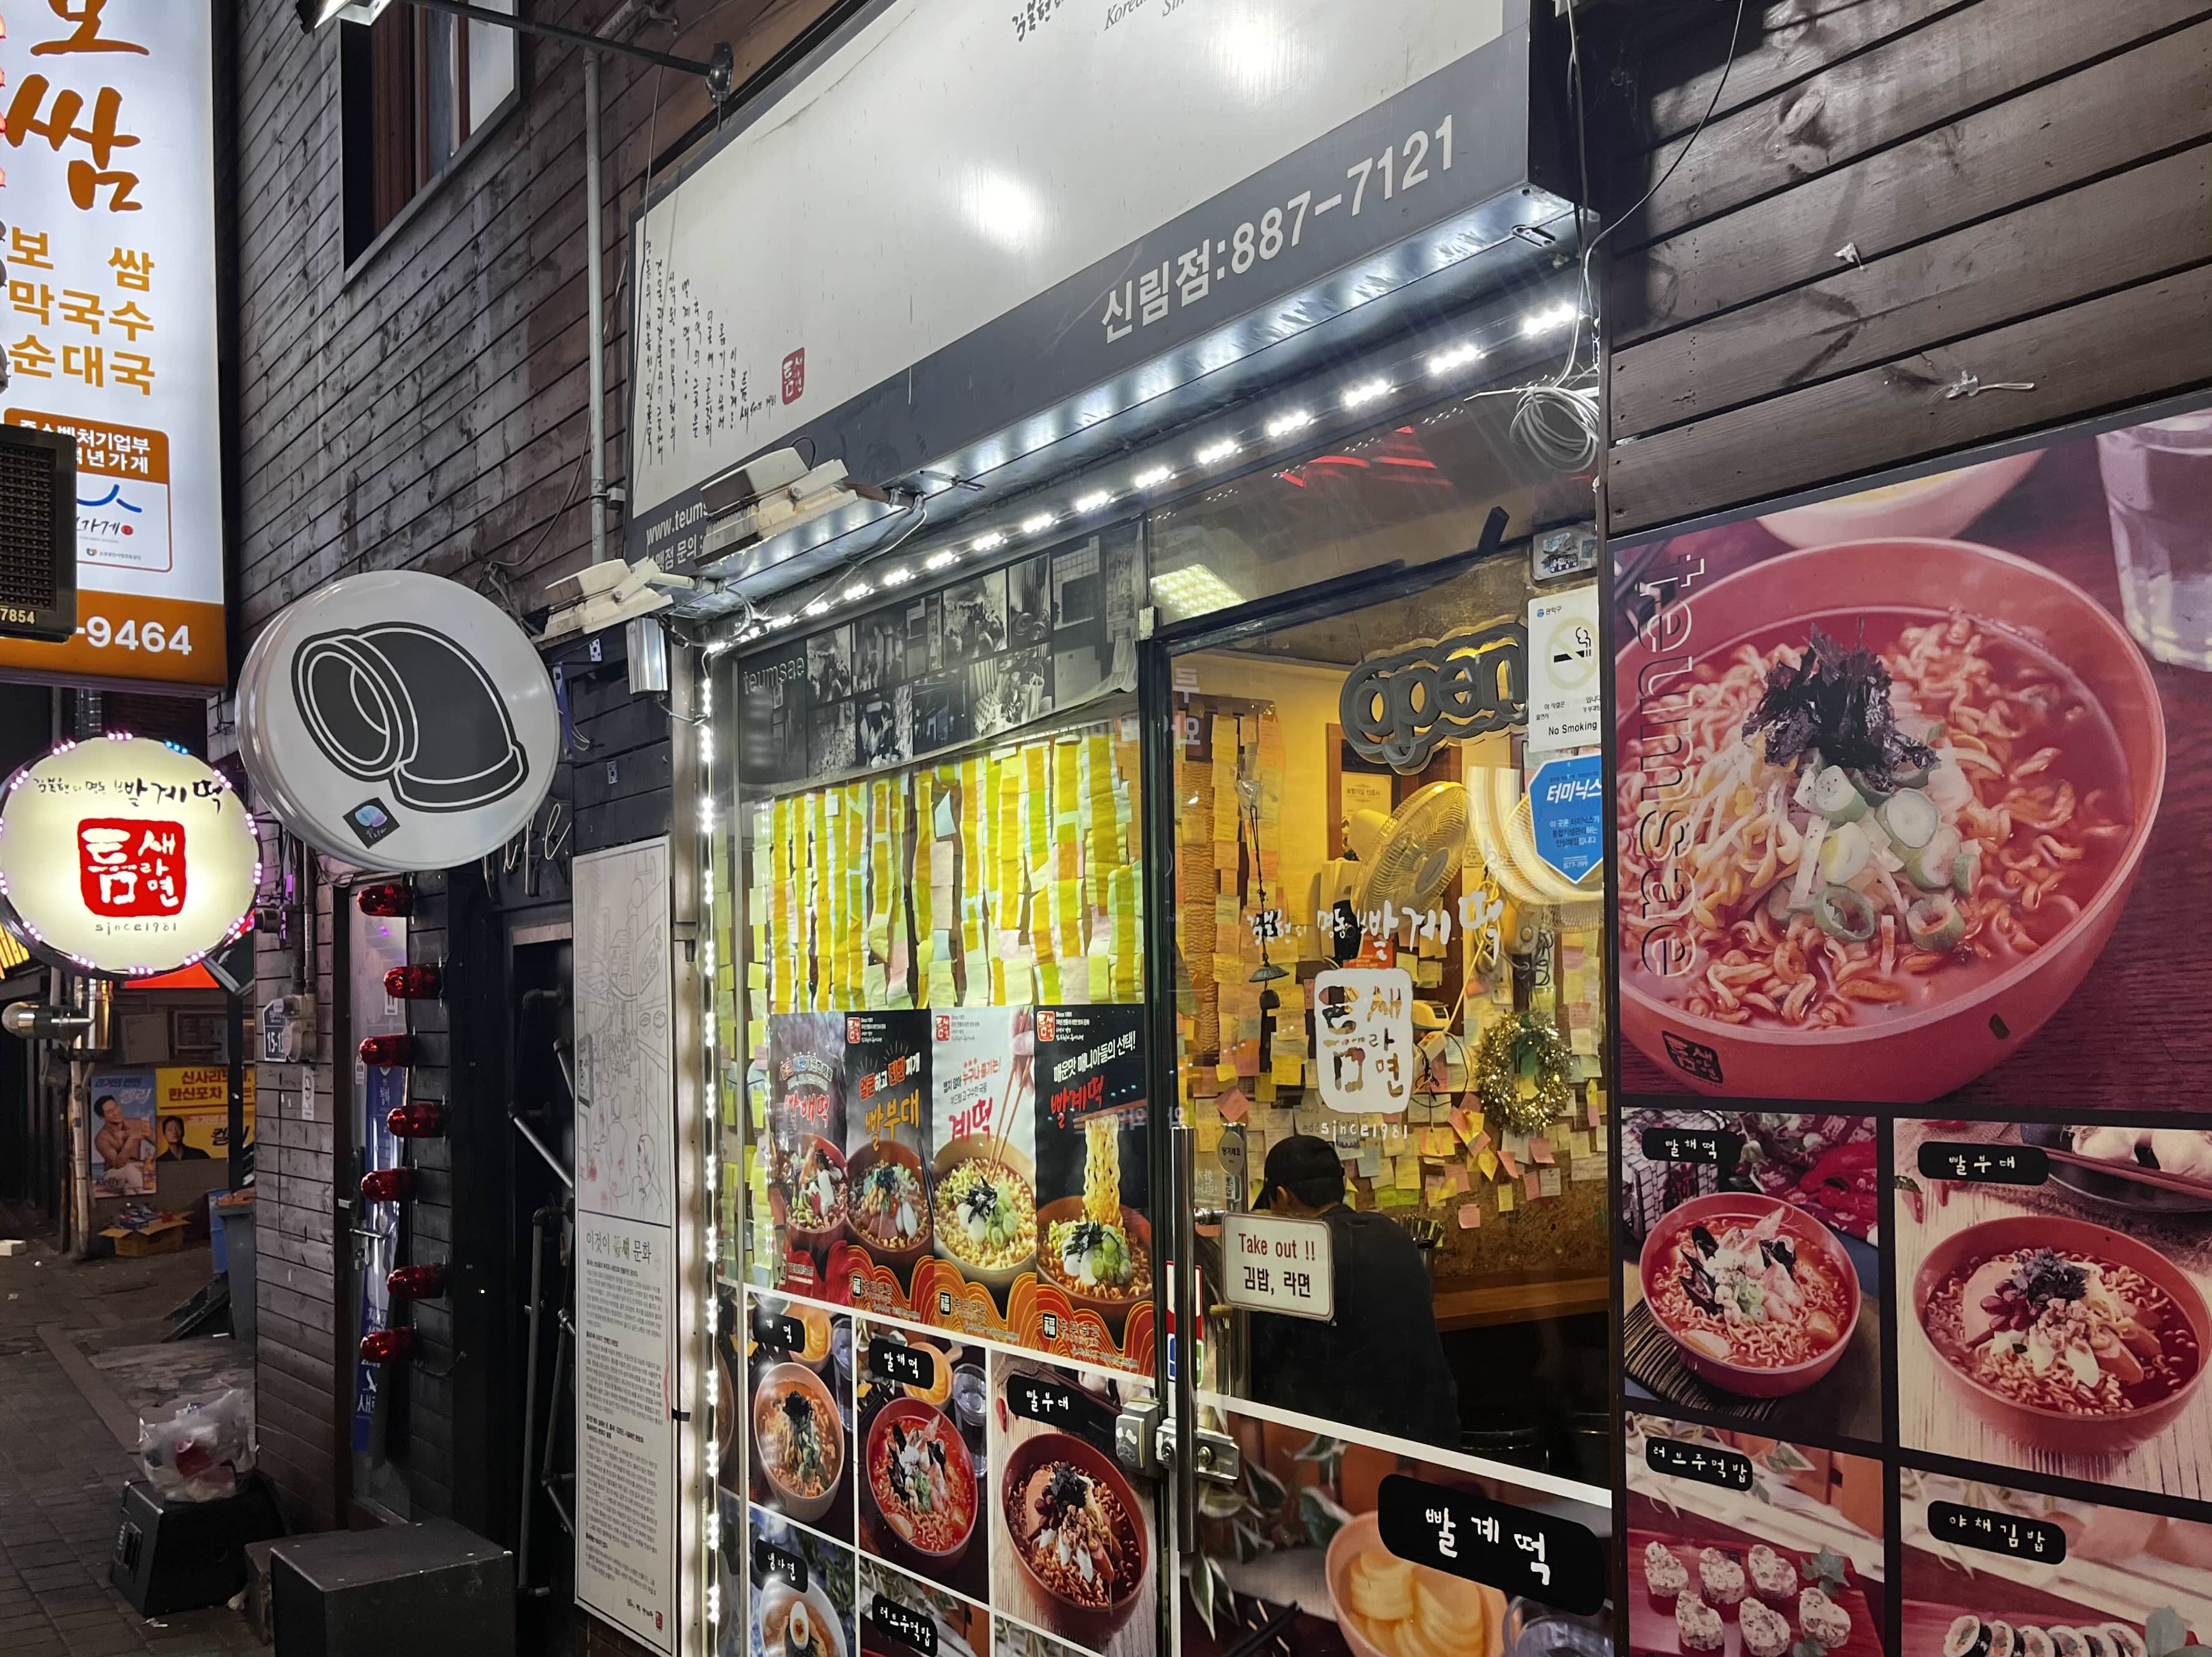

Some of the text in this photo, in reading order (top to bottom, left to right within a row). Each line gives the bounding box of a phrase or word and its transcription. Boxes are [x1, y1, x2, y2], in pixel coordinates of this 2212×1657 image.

[1012, 0, 1060, 42] 김복현
[9, 279, 154, 342] 막국수
[8, 334, 155, 396] 순대국
[76, 447, 148, 474] 년가게
[76, 516, 121, 535] 가게
[651, 545, 674, 571] 맹점
[0, 607, 35, 624] 7854
[1549, 720, 1597, 736] No Smoking
[1546, 778, 1602, 804] 터미닉스
[1053, 1056, 1076, 1083] 매운맛
[1077, 1038, 1116, 1073] 매니아들의
[1117, 1030, 1137, 1056] 선택!
[962, 1065, 980, 1086] 누구나
[1050, 1074, 1105, 1129] 빨계떡
[949, 1096, 993, 1144] 계떡
[1948, 1153, 2017, 1176] 빨부대
[586, 1228, 610, 1256] 이것이
[633, 1240, 652, 1265] 문화
[1238, 1232, 1268, 1256] Take
[1275, 1239, 1298, 1259] out
[1243, 1265, 1312, 1299] 김밥, 라면
[1426, 1507, 1551, 1586] 빨계떡
[1949, 1513, 2046, 1552] 야채김밥
